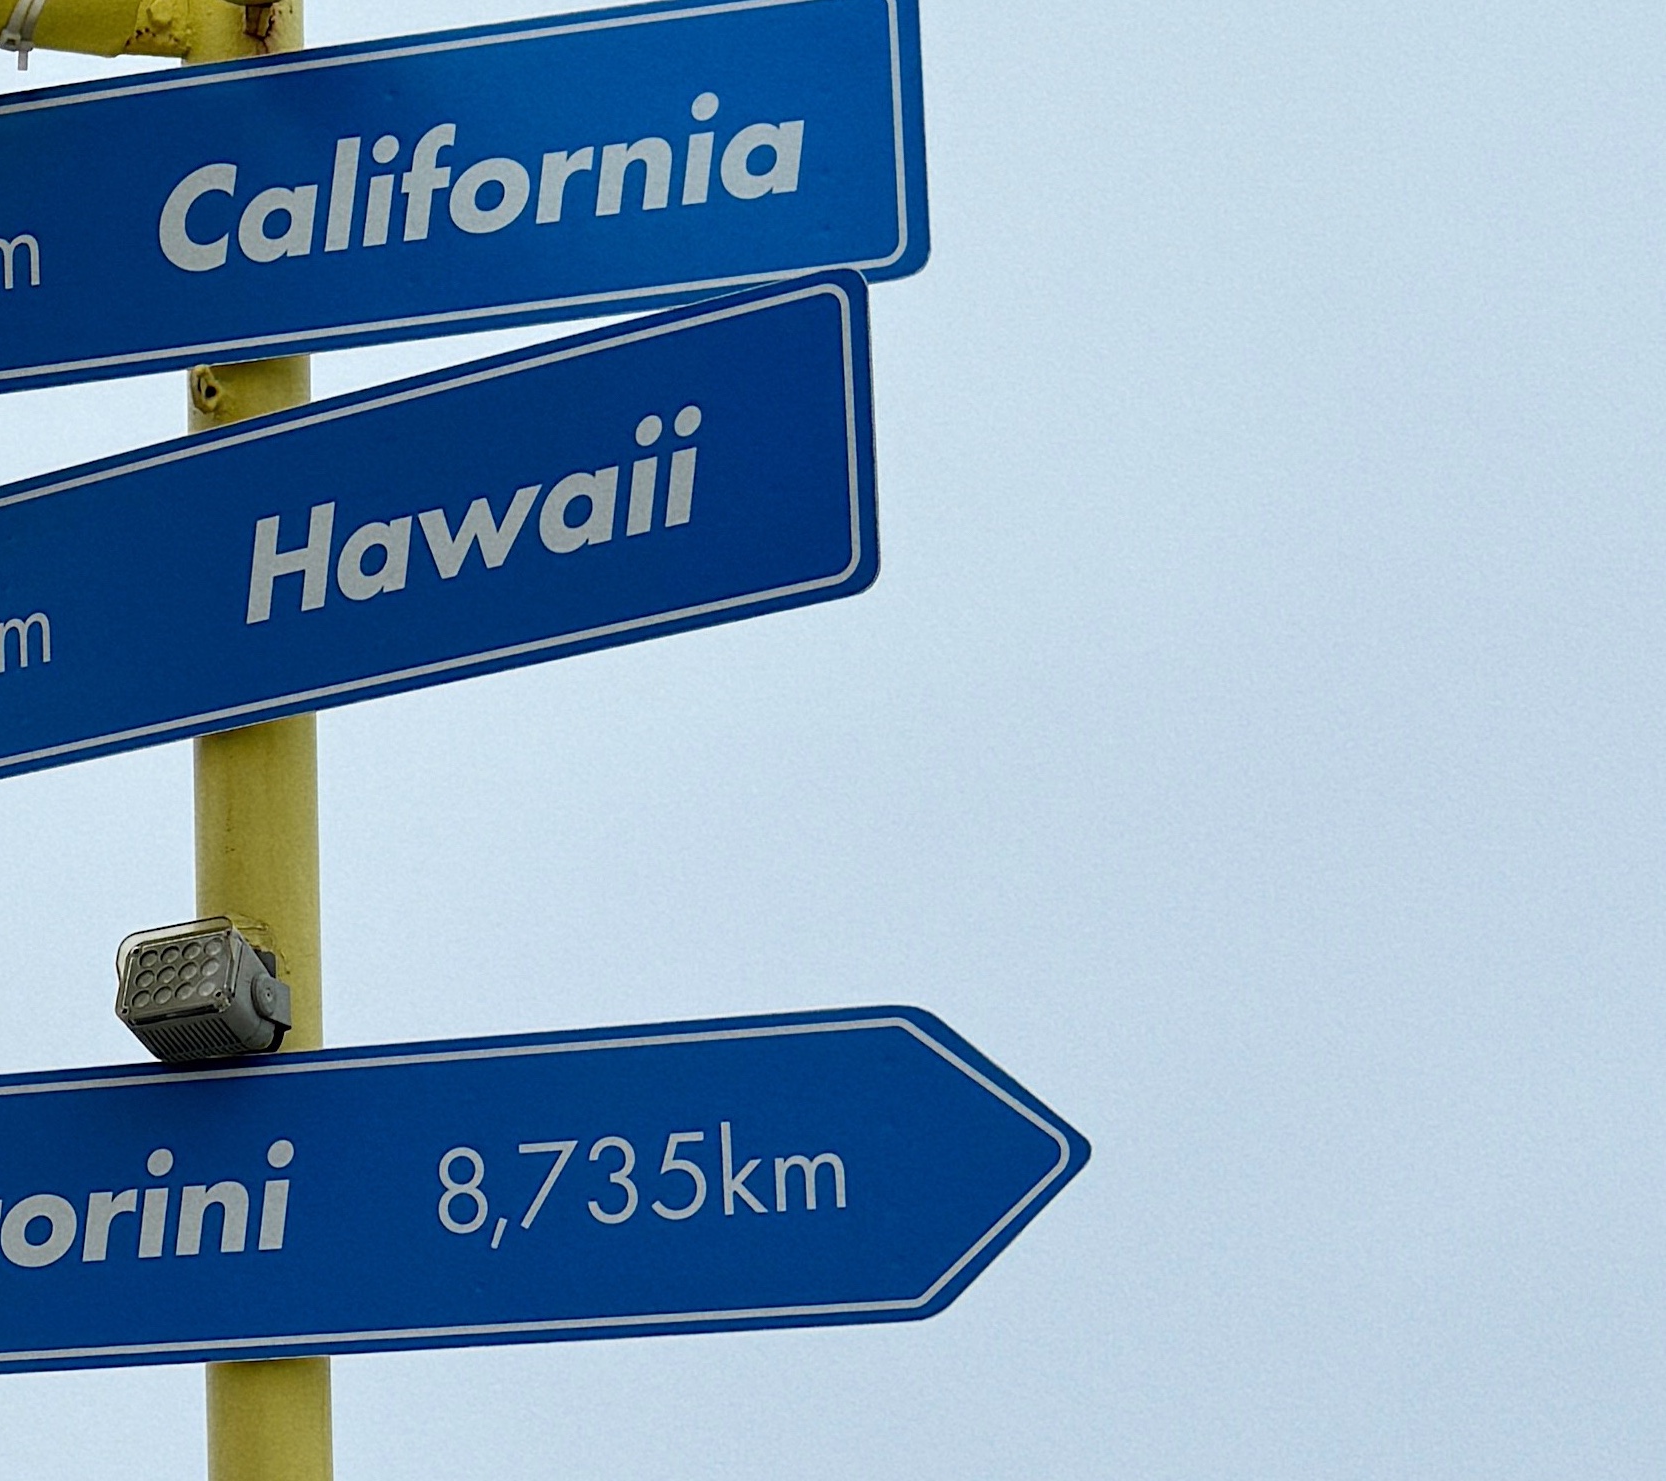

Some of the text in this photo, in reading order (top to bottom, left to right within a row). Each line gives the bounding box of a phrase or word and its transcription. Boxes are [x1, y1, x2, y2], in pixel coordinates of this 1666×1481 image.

[158, 92, 805, 273] California
[245, 405, 703, 626] Hawaii
[437, 1121, 847, 1250] 8,735km
